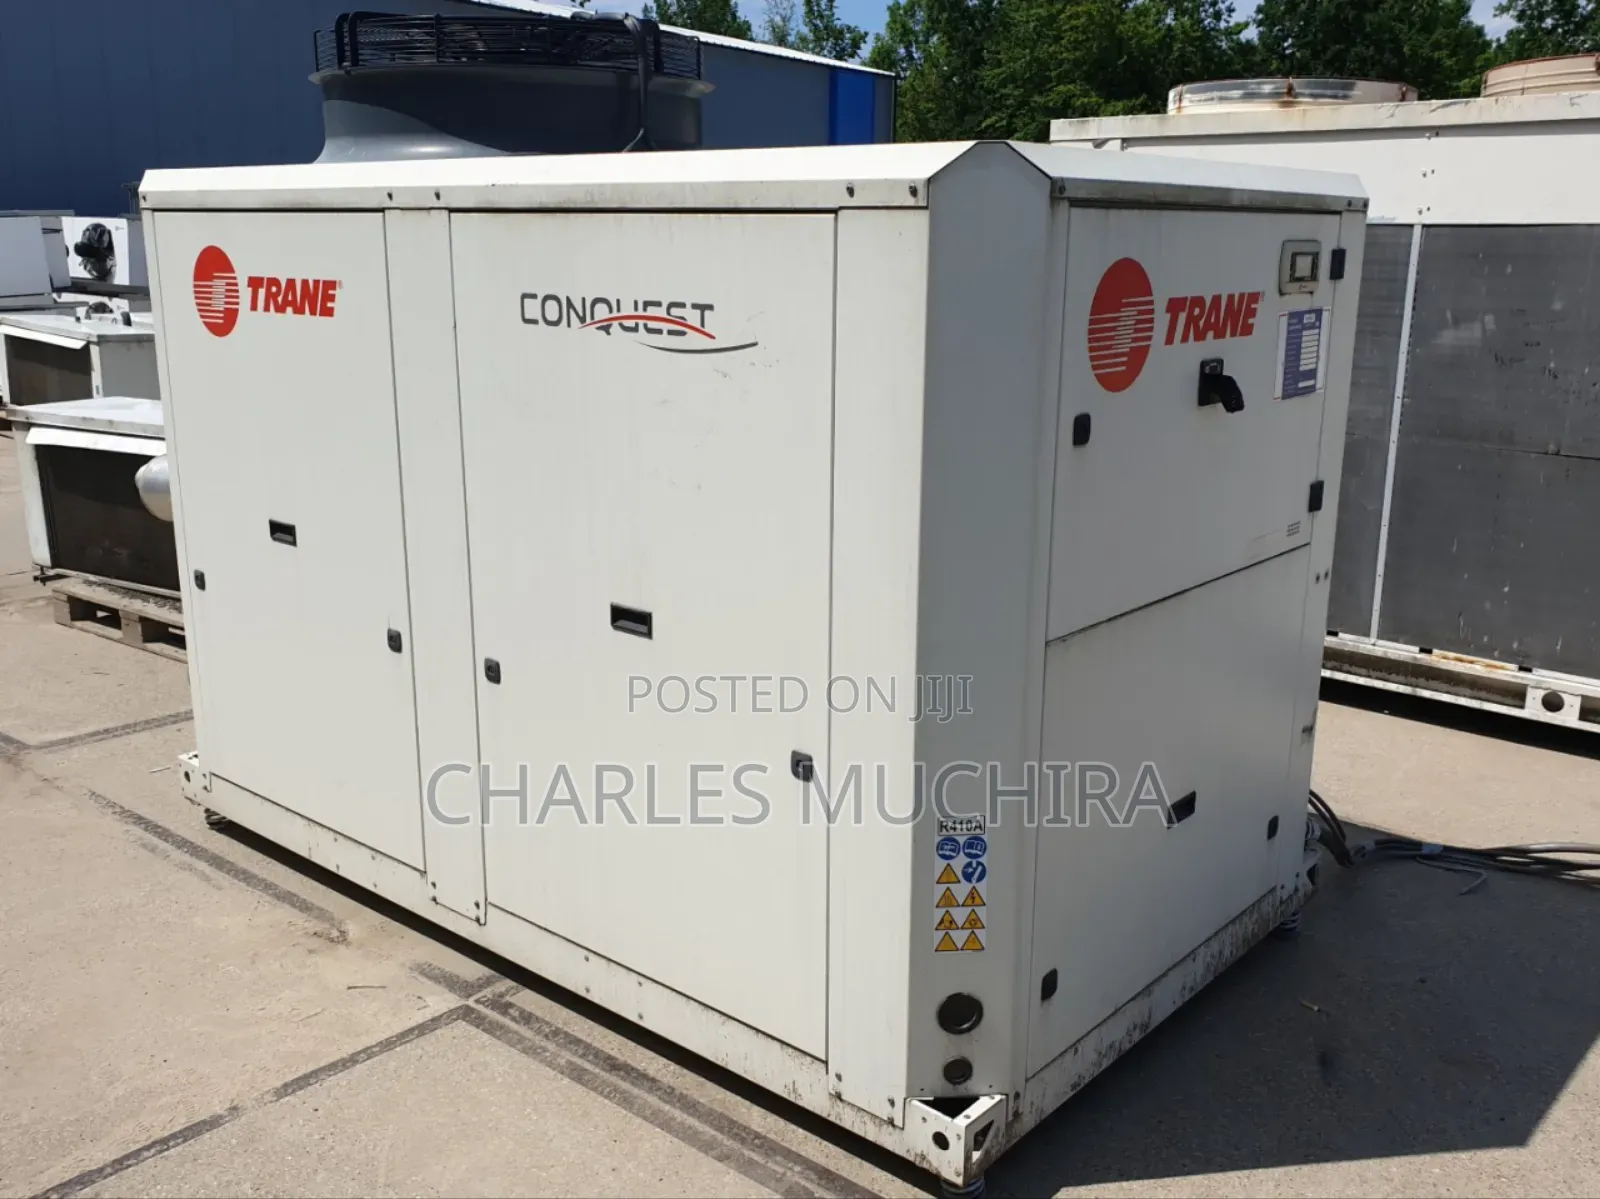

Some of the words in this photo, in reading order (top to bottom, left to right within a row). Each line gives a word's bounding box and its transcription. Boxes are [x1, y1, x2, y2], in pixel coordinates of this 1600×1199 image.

[247, 275, 337, 318] TRANE
[519, 291, 715, 337] CONQUEST
[1163, 291, 1261, 346] TRANE
[938, 817, 984, 834] R410A
